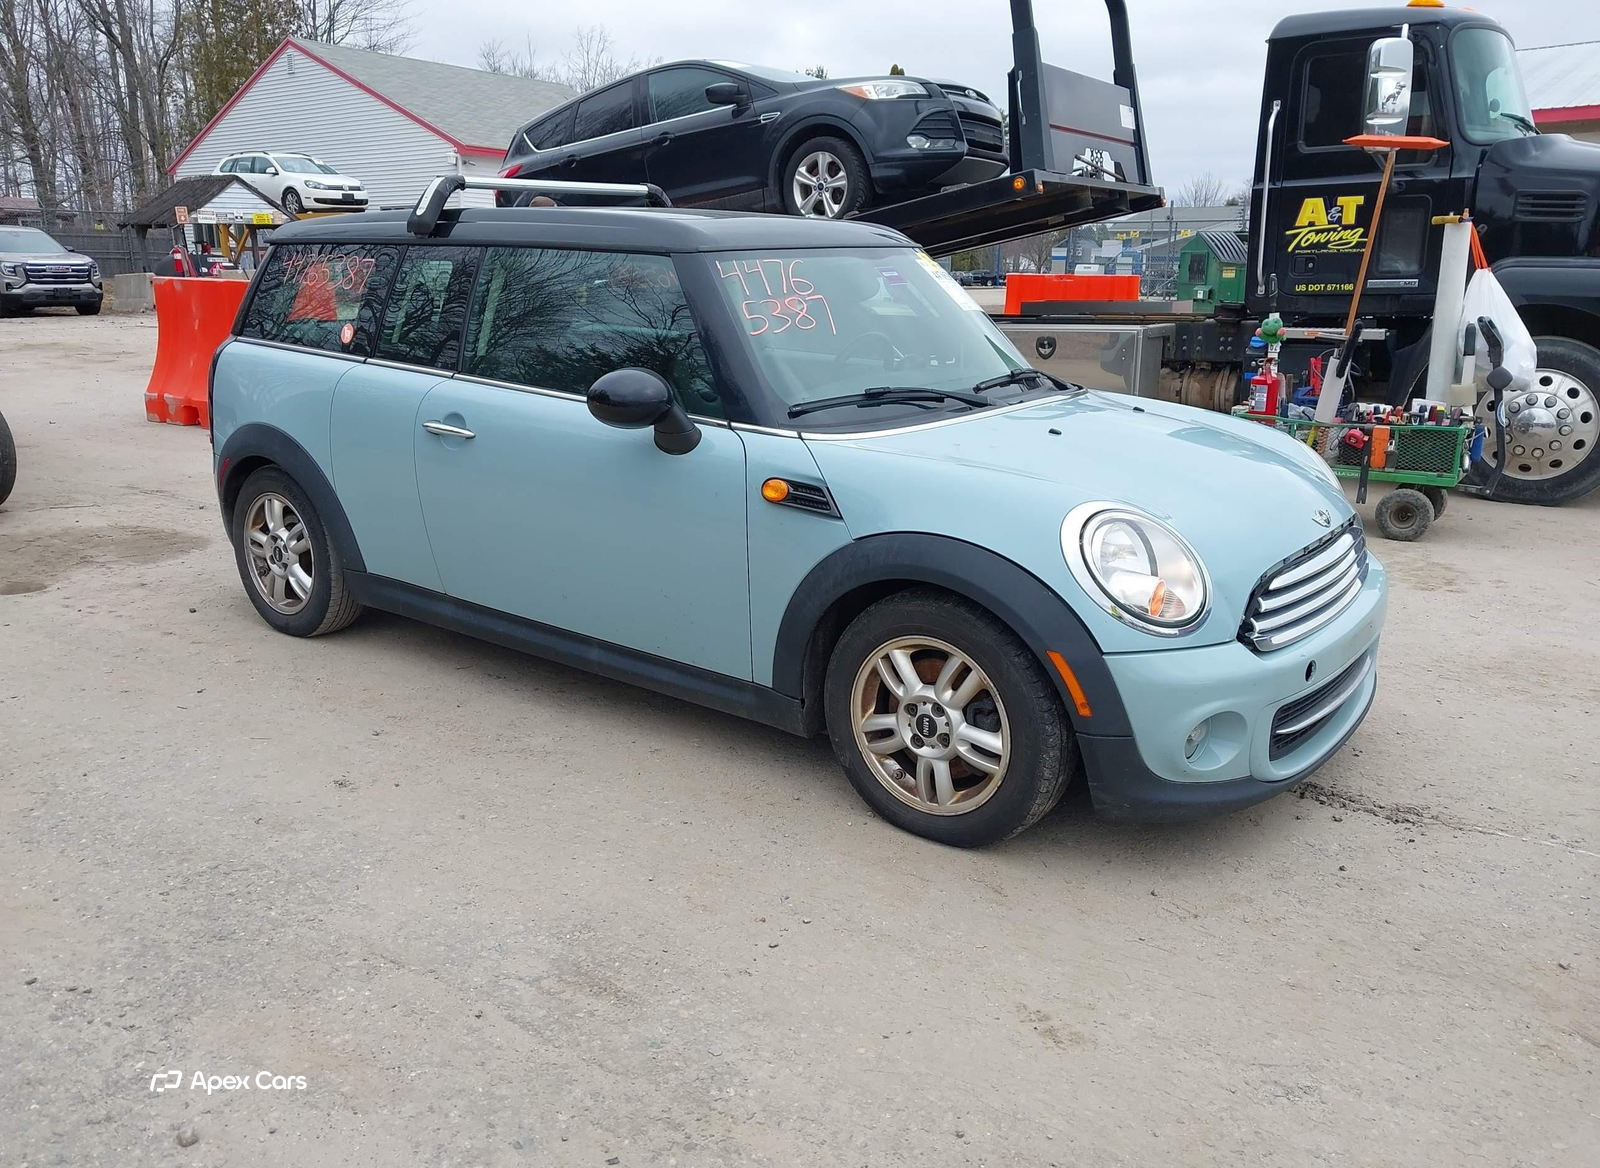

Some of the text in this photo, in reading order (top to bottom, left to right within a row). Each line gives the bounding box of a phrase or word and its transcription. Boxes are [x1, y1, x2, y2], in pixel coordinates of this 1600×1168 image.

[1285, 224, 1369, 252] Towing
[282, 251, 375, 294] 44765387
[715, 259, 815, 296] 4476
[1308, 283, 1325, 291] DOT
[742, 294, 836, 335] 5387
[922, 717, 930, 735] MINI
